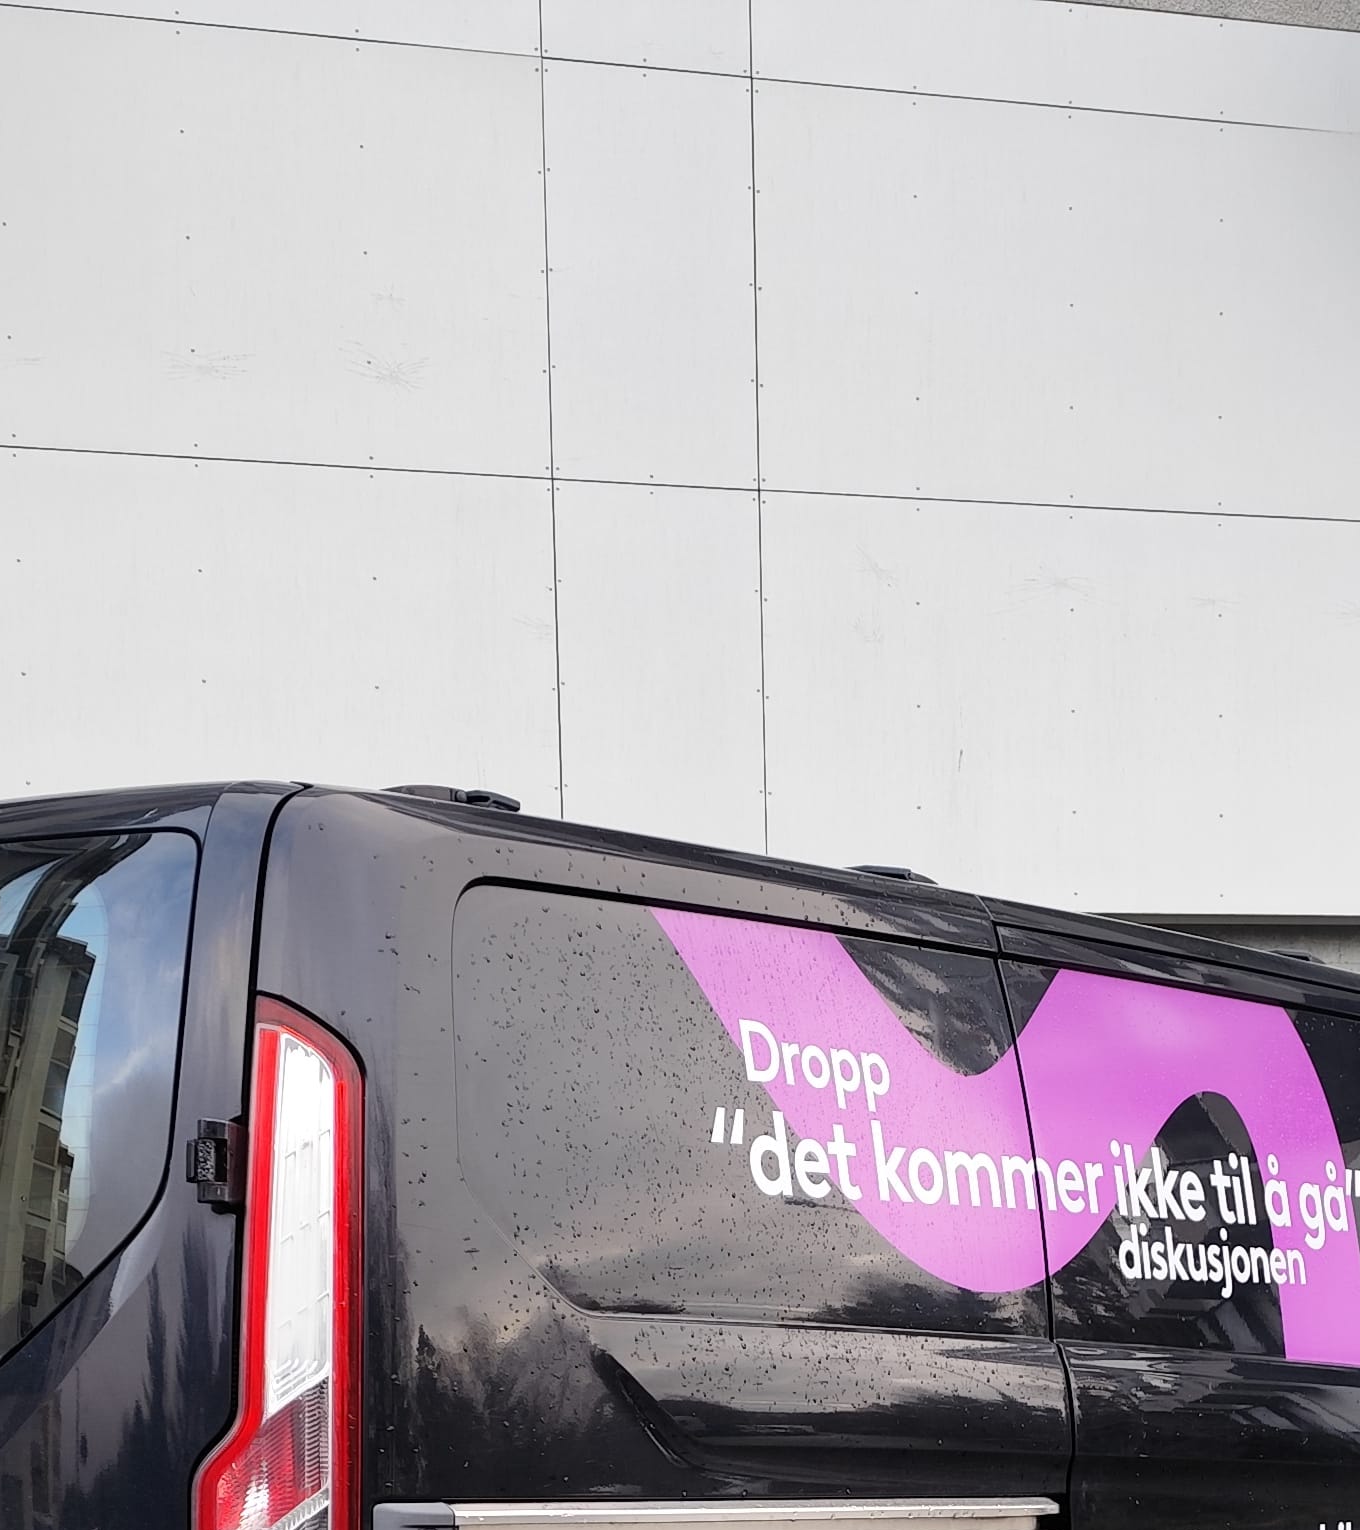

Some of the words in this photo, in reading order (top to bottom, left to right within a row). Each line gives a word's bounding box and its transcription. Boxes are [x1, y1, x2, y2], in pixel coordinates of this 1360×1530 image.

[739, 1018, 891, 1112] Dropp
[710, 1107, 861, 1200] "det
[871, 1120, 1103, 1214] kommer
[1110, 1139, 1205, 1222] ikke
[1210, 1152, 1256, 1226] til
[1265, 1154, 1292, 1228] å
[1118, 1223, 1307, 1298] diskusjonen
